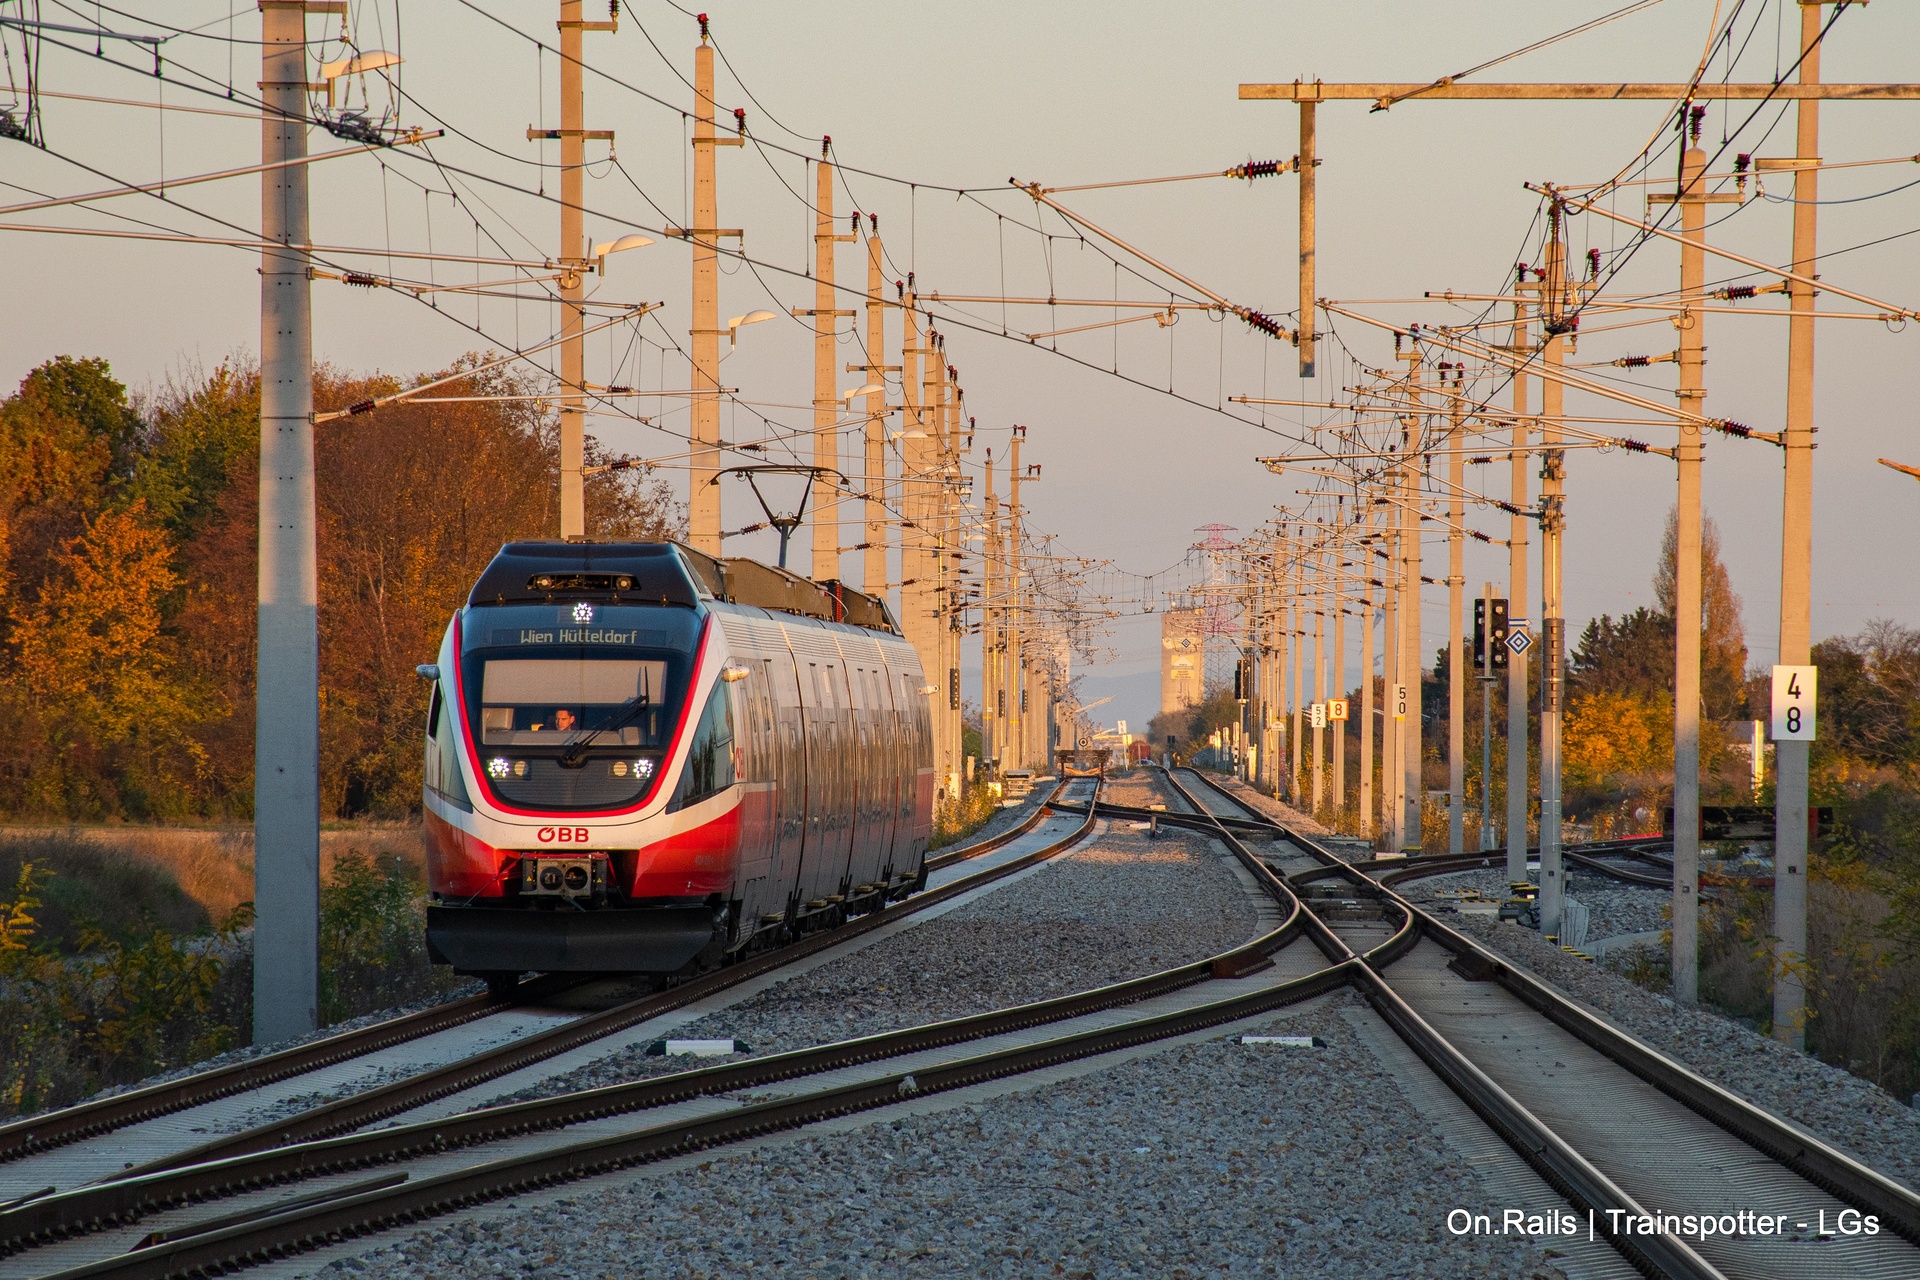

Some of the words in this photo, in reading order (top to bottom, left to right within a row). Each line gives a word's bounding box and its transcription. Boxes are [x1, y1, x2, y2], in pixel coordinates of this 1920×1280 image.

[520, 629, 553, 644] Wien
[559, 628, 638, 644] Hütteldorf
[1787, 672, 1802, 699] 4
[1398, 687, 1406, 699] 5
[1315, 706, 1321, 715] 5
[1334, 703, 1343, 716] 8
[1398, 702, 1406, 714] 0
[1315, 717, 1321, 726] 2
[1786, 706, 1802, 733] 8
[537, 827, 589, 843] ÖBB
